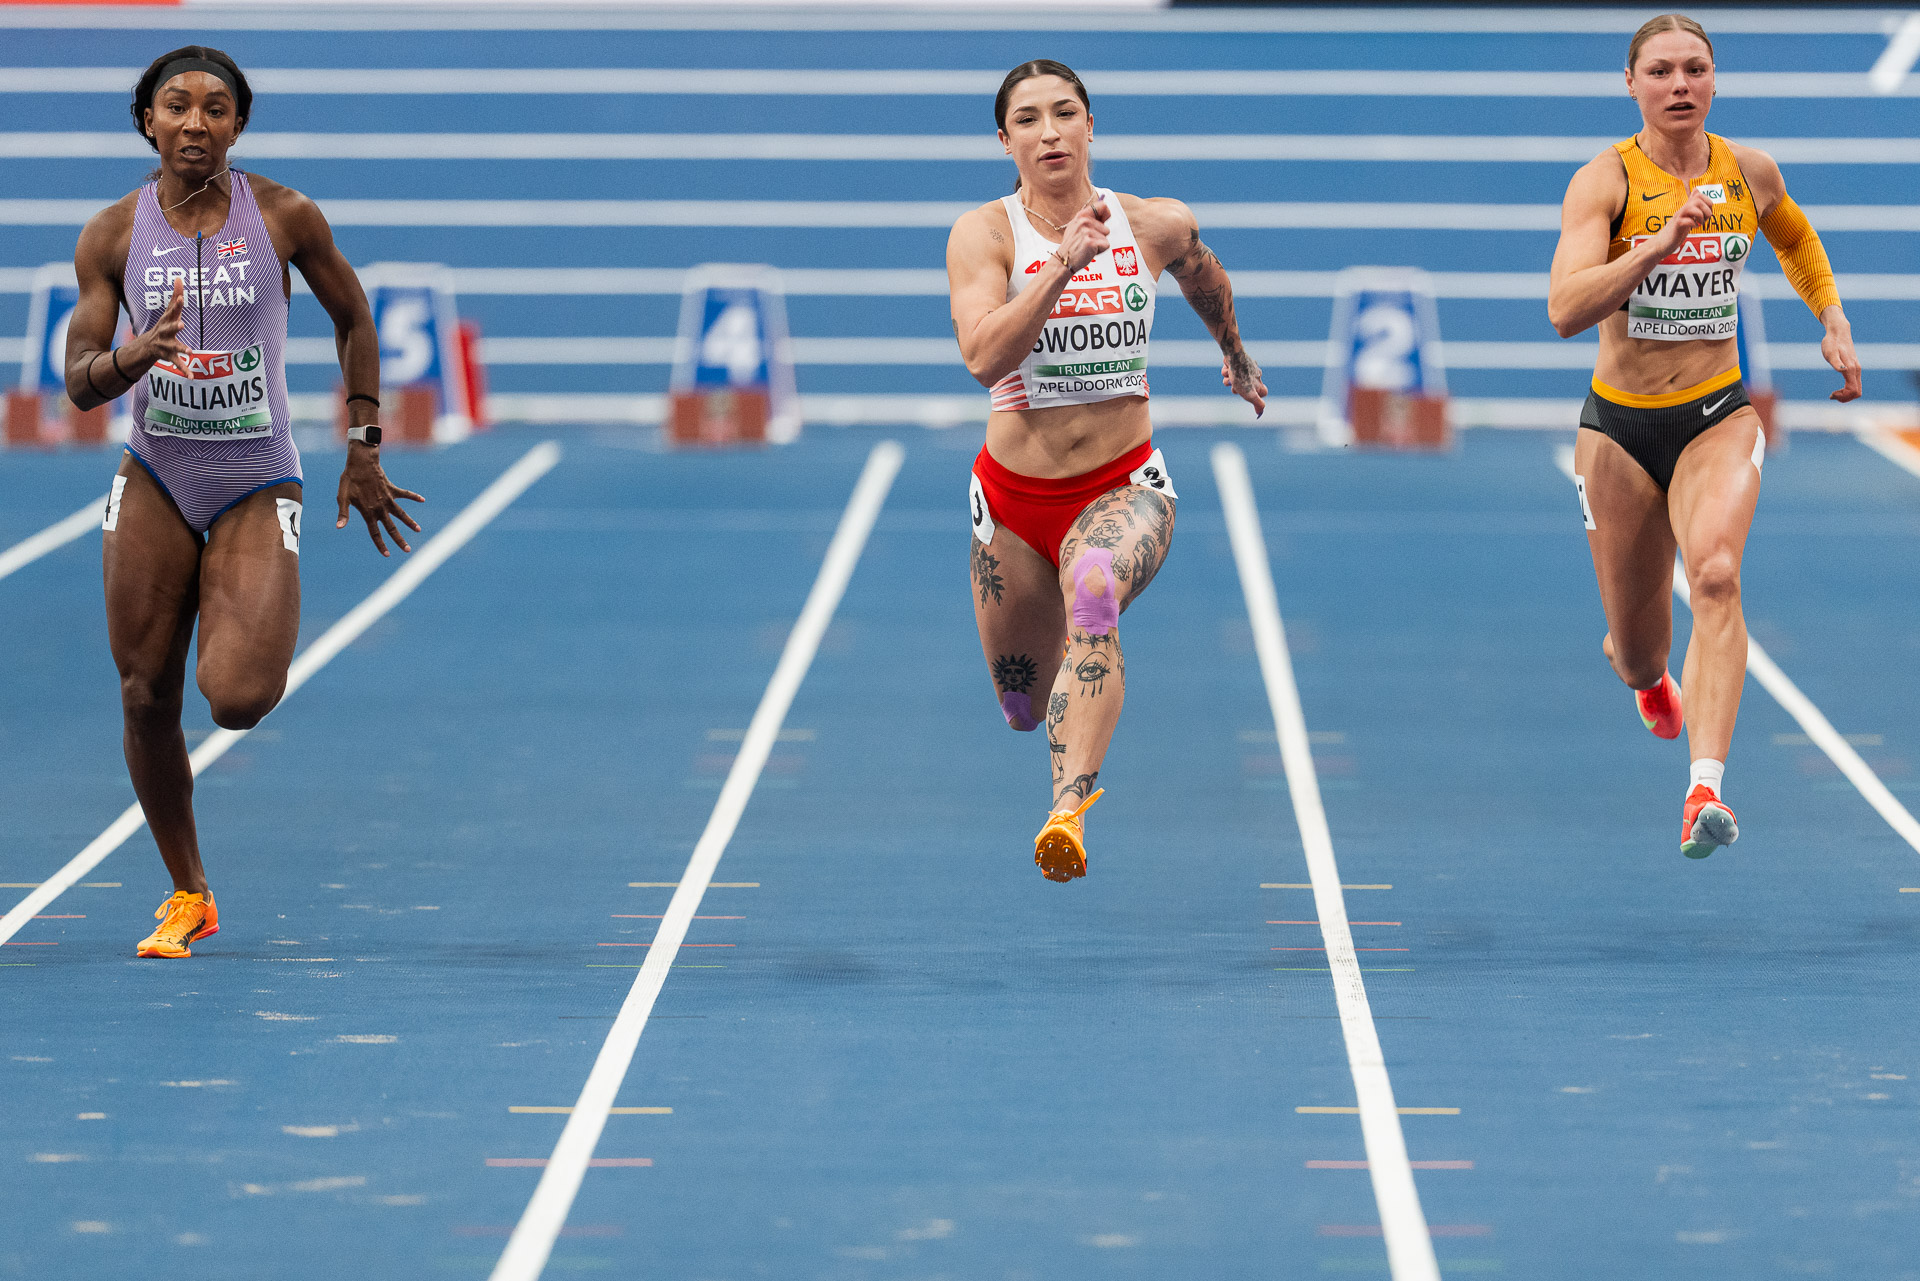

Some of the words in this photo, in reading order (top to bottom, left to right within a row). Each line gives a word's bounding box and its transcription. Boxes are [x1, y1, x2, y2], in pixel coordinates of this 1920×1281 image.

[144, 260, 251, 286] GREAT
[1071, 273, 1103, 283] ORLEN
[1637, 268, 1735, 298] MAYER
[1051, 290, 1121, 315] PAR
[1656, 309, 1659, 318] I
[1661, 309, 1686, 319] RUN
[1633, 322, 1715, 335] APELDOORN
[1718, 320, 1736, 334] 2025
[381, 301, 432, 382] 5
[702, 300, 761, 384] 4
[1355, 305, 1415, 388] 2
[1059, 366, 1063, 375] I
[1065, 365, 1091, 375] RUN
[149, 373, 264, 411] WILLIAMS
[1038, 377, 1123, 393] APELDOORN
[170, 415, 174, 425] I
[175, 417, 199, 430] RUN
